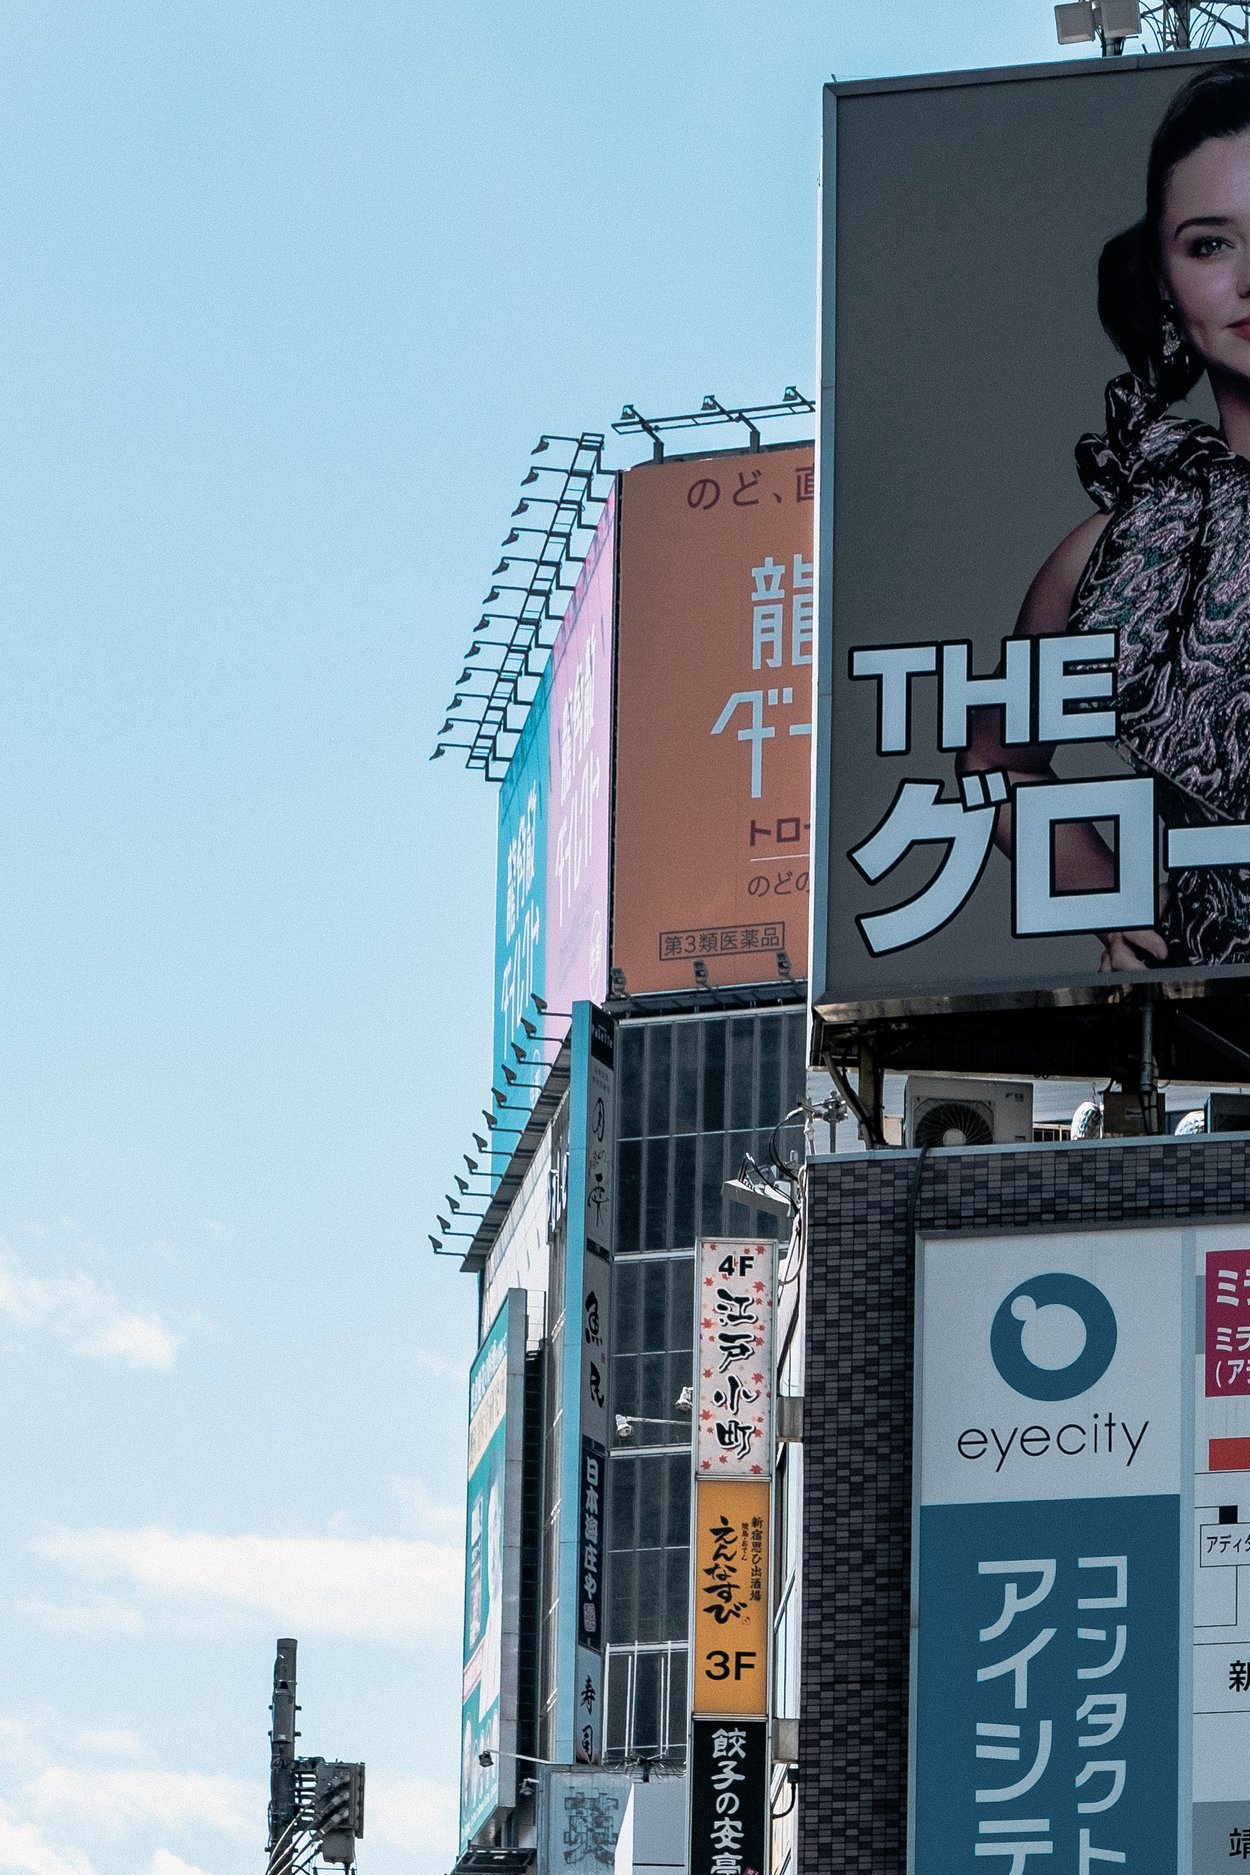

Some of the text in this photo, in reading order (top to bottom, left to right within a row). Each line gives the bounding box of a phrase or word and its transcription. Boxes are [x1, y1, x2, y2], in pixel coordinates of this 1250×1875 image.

[851, 633, 1117, 753] THE
[664, 925, 780, 956] 第3類医薬品
[718, 1254, 755, 1277] 4F
[716, 1288, 758, 1460] 江戸小町
[957, 1413, 1149, 1472] eyecity
[702, 1515, 748, 1624] えんなすび
[705, 1650, 757, 1681] 3F
